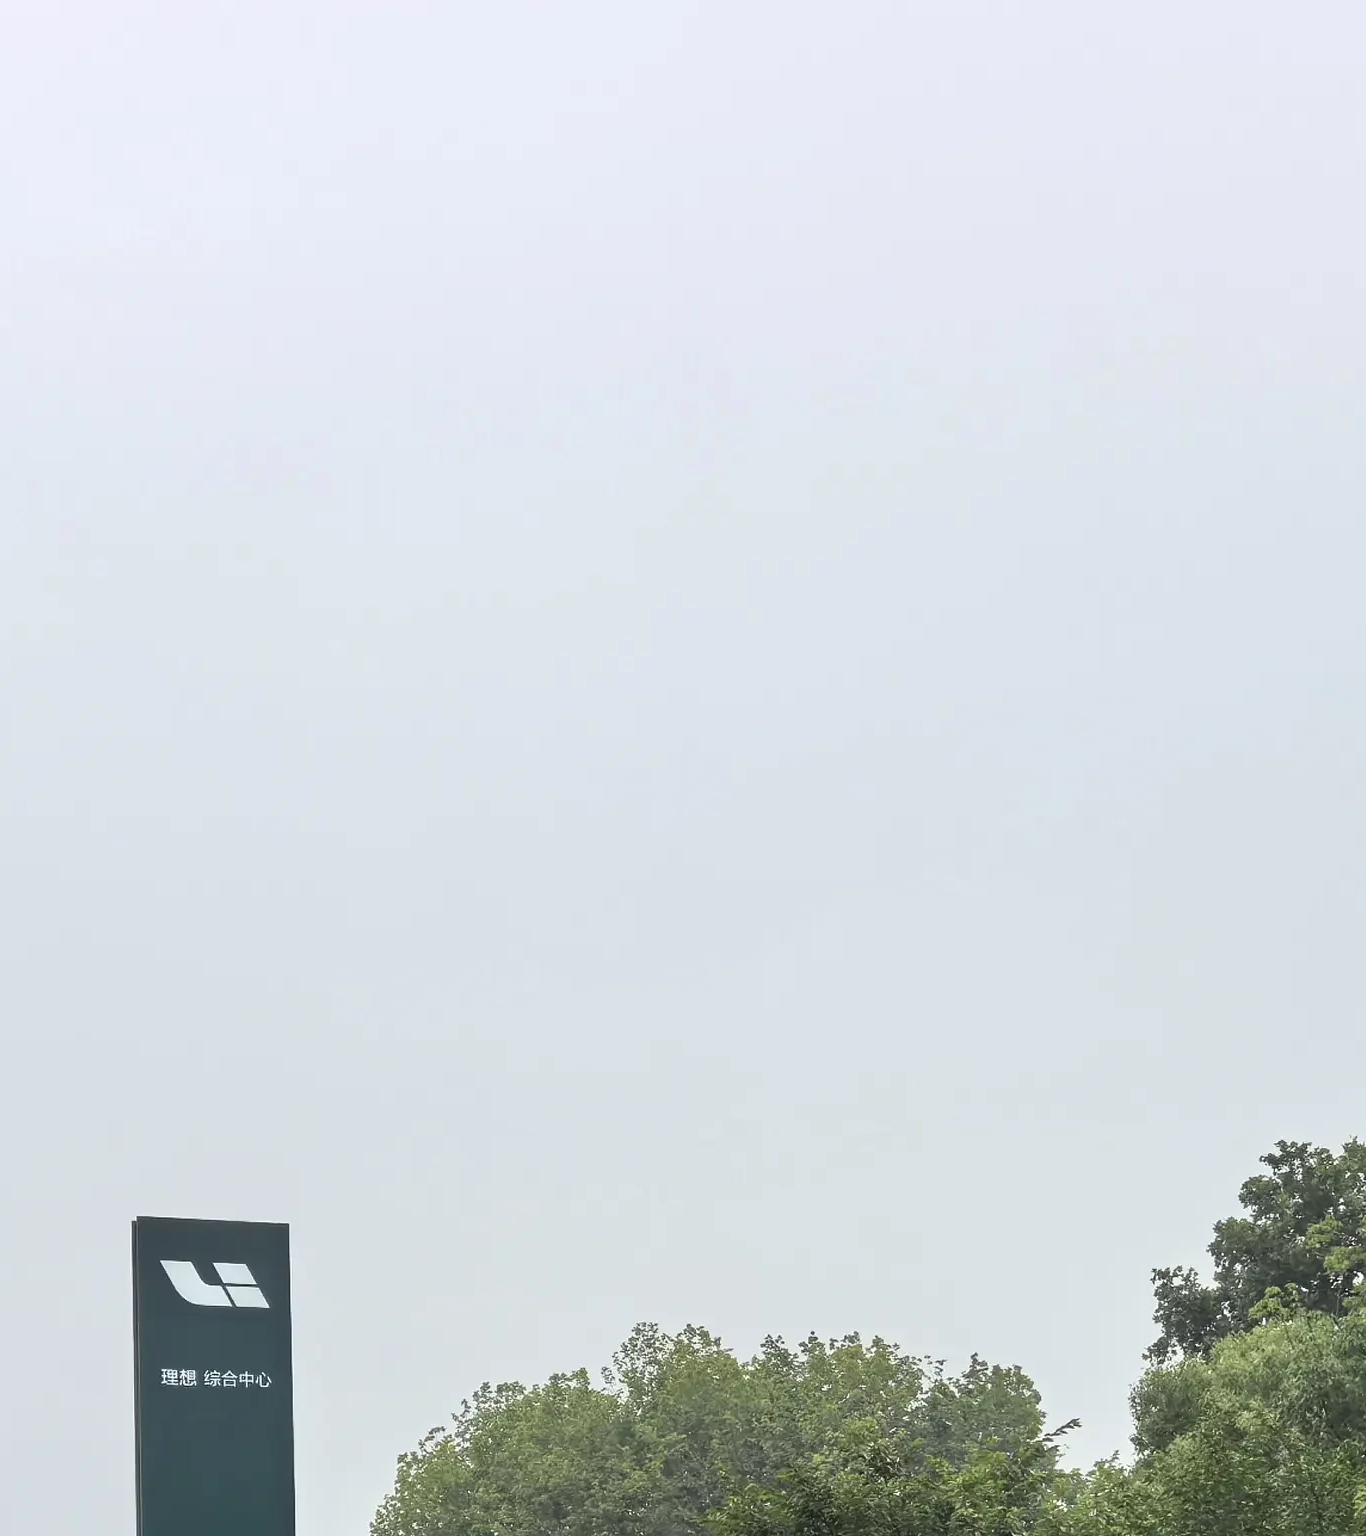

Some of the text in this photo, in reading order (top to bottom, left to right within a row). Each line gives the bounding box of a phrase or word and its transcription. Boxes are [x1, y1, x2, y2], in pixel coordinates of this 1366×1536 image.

[160, 1368, 272, 1388] 理想 综合中心
